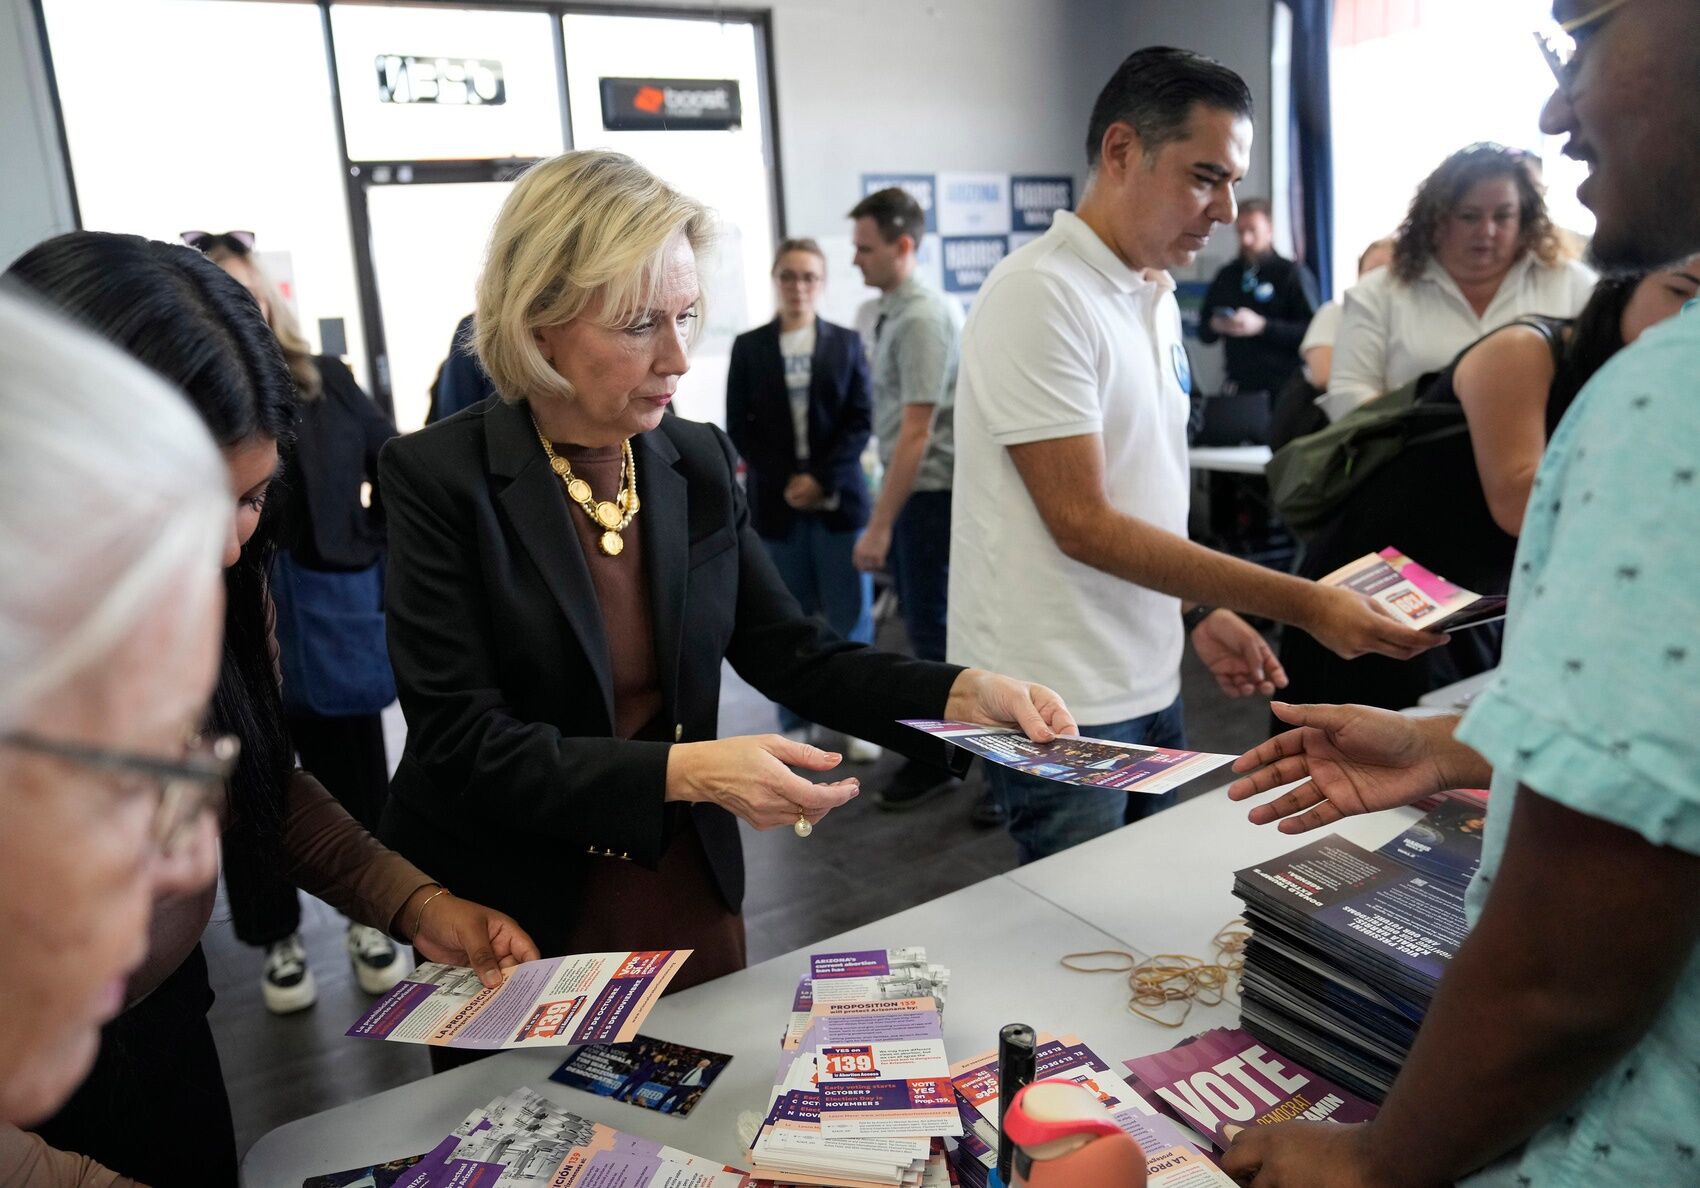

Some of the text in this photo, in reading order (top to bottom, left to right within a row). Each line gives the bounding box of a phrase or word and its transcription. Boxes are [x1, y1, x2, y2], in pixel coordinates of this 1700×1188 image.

[664, 87, 728, 109] boost
[1013, 182, 1070, 210] HARRIS
[1274, 875, 1313, 896] EXTREME
[1288, 888, 1323, 906] DONALD
[1342, 906, 1383, 926] FREEDOMS
[1347, 922, 1420, 957] VICE PRESIDENT
[1403, 928, 1421, 938] OUR
[1421, 937, 1441, 946] AND
[1390, 935, 1431, 955] KAMALA
[617, 956, 641, 975] Vote
[629, 966, 644, 974] Sí
[844, 960, 877, 968] abortion
[830, 1002, 898, 1010] PROPOSITION
[527, 1001, 576, 1034] 139
[435, 1028, 449, 1039] LA
[580, 1030, 593, 1039] EL
[598, 1029, 610, 1038] EL
[596, 1051, 635, 1064] KAMALA
[831, 1055, 871, 1072] 139
[984, 1078, 997, 1088] Sí
[1154, 1044, 1310, 1133] VOTE
[1295, 1092, 1345, 1122] AMIN
[1146, 1152, 1173, 1165] proteger
[1170, 1155, 1188, 1166] LA
[451, 1163, 468, 1182] actual
[460, 1162, 478, 1187] Arizona
[552, 1152, 581, 1188] ICIÓN 139
[564, 1161, 582, 1188] rizonenses
